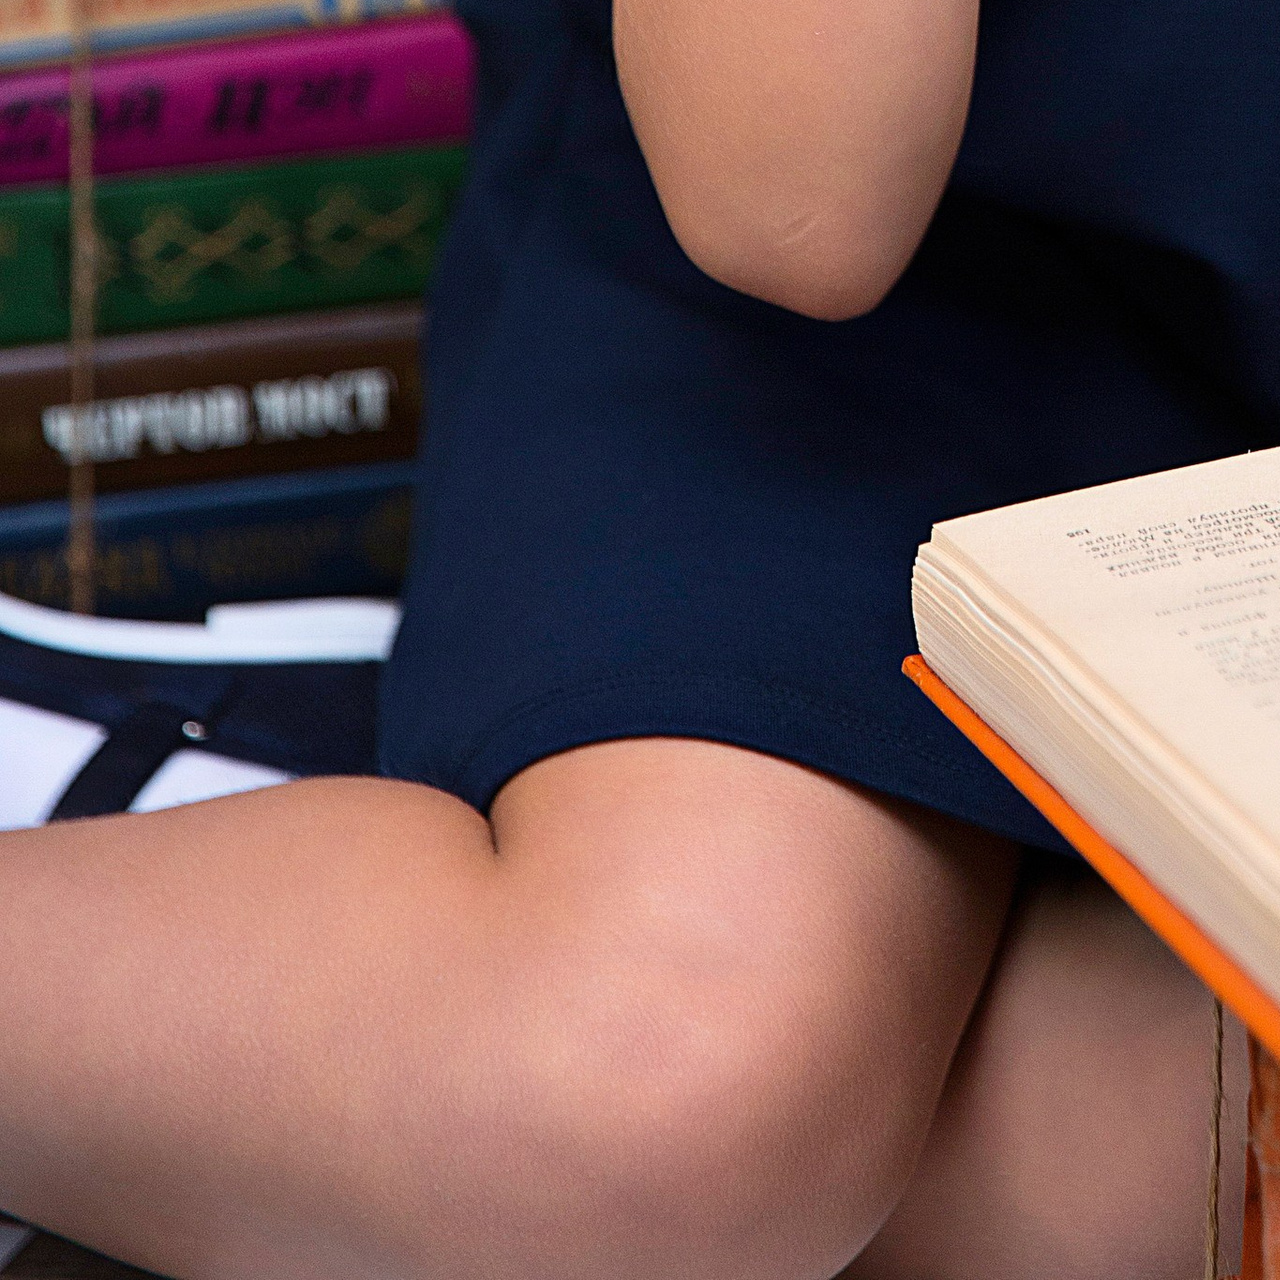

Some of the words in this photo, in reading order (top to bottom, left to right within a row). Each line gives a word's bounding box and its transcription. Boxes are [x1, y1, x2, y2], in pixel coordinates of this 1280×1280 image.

[1187, 503, 1270, 524] протянул
[1137, 522, 1177, 535] свой
[1163, 528, 1184, 536] на
[1183, 521, 1254, 539] вальтер
[1232, 527, 1261, 538] три
[1078, 532, 1127, 547] пара-
[1085, 533, 1155, 553] Мюлле-
[1194, 539, 1246, 553] особо
[1093, 542, 1151, 559] протя-
[1106, 552, 1178, 572] важных
[1118, 560, 1182, 578] подвал.
